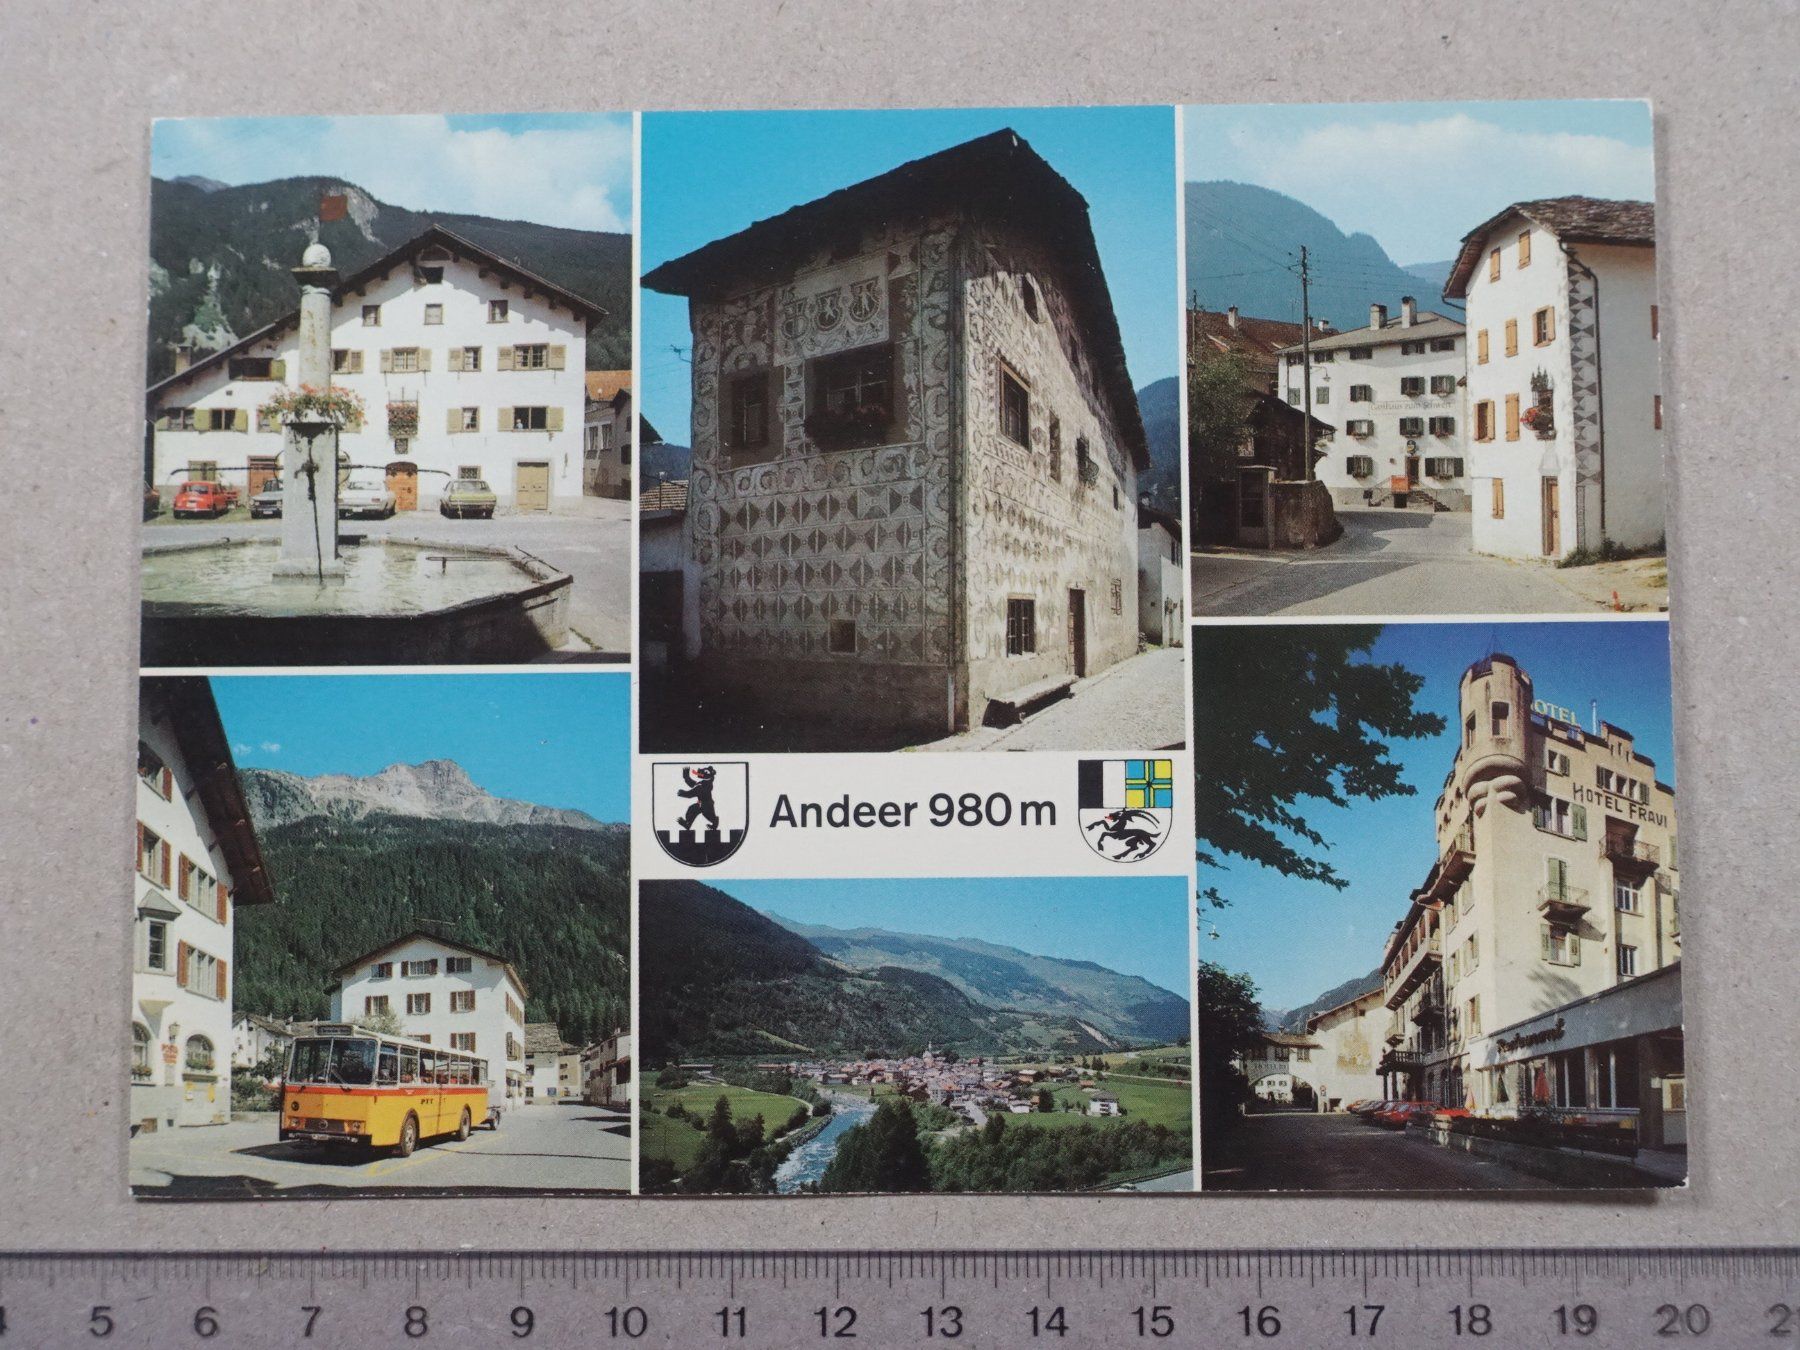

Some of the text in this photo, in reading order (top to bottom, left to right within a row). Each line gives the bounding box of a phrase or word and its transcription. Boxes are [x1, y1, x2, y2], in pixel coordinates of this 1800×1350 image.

[1531, 699, 1581, 726] OTEL
[769, 792, 1056, 828] Andeer 980 m
[1573, 782, 1668, 828] HOTEL FRAVI
[90, 1303, 1800, 1338] 5 6 7 8 9 10 11 12 13 14 15 16 17 18 19 20 2
